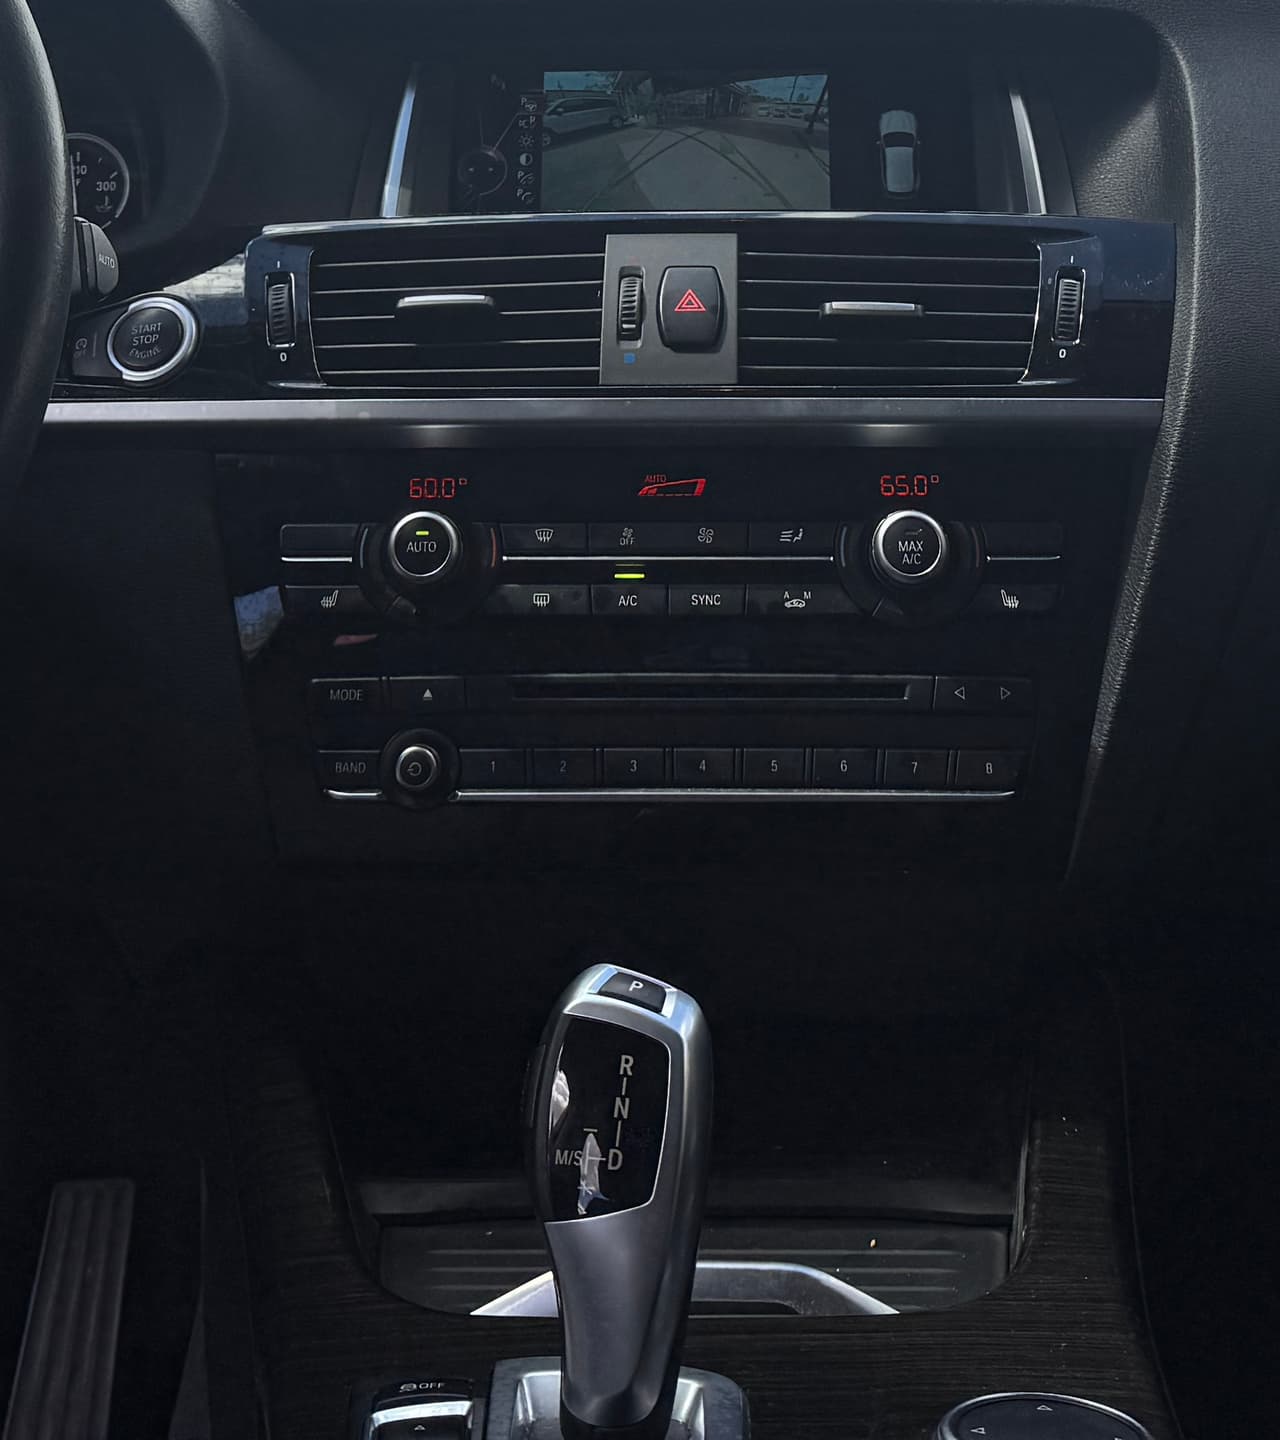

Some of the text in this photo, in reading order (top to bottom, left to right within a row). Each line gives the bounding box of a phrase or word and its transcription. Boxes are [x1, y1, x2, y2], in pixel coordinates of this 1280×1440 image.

[96, 181, 116, 192] 300
[98, 253, 115, 268] AUTO
[131, 322, 162, 335] START
[132, 334, 160, 346] STOP
[406, 541, 437, 553] AUTO
[619, 537, 635, 546] OFF
[898, 541, 924, 553] MAX
[902, 553, 921, 565] A/C
[618, 595, 638, 607] A/C
[690, 594, 721, 607] SYNC
[329, 689, 364, 702] MODE
[335, 761, 367, 774] BAND
[490, 761, 496, 772] 1
[560, 761, 568, 772] 2
[630, 760, 638, 772] 3
[699, 760, 707, 772] 4
[770, 760, 778, 772] 5
[840, 760, 848, 772] 6
[911, 761, 918, 774] 7
[985, 762, 993, 775] 8
[629, 980, 643, 992] P
[620, 1054, 634, 1076] R
[613, 1096, 630, 1120] N
[554, 1149, 583, 1167] M/S
[608, 1148, 624, 1171] D
[419, 1382, 445, 1390] OFF
